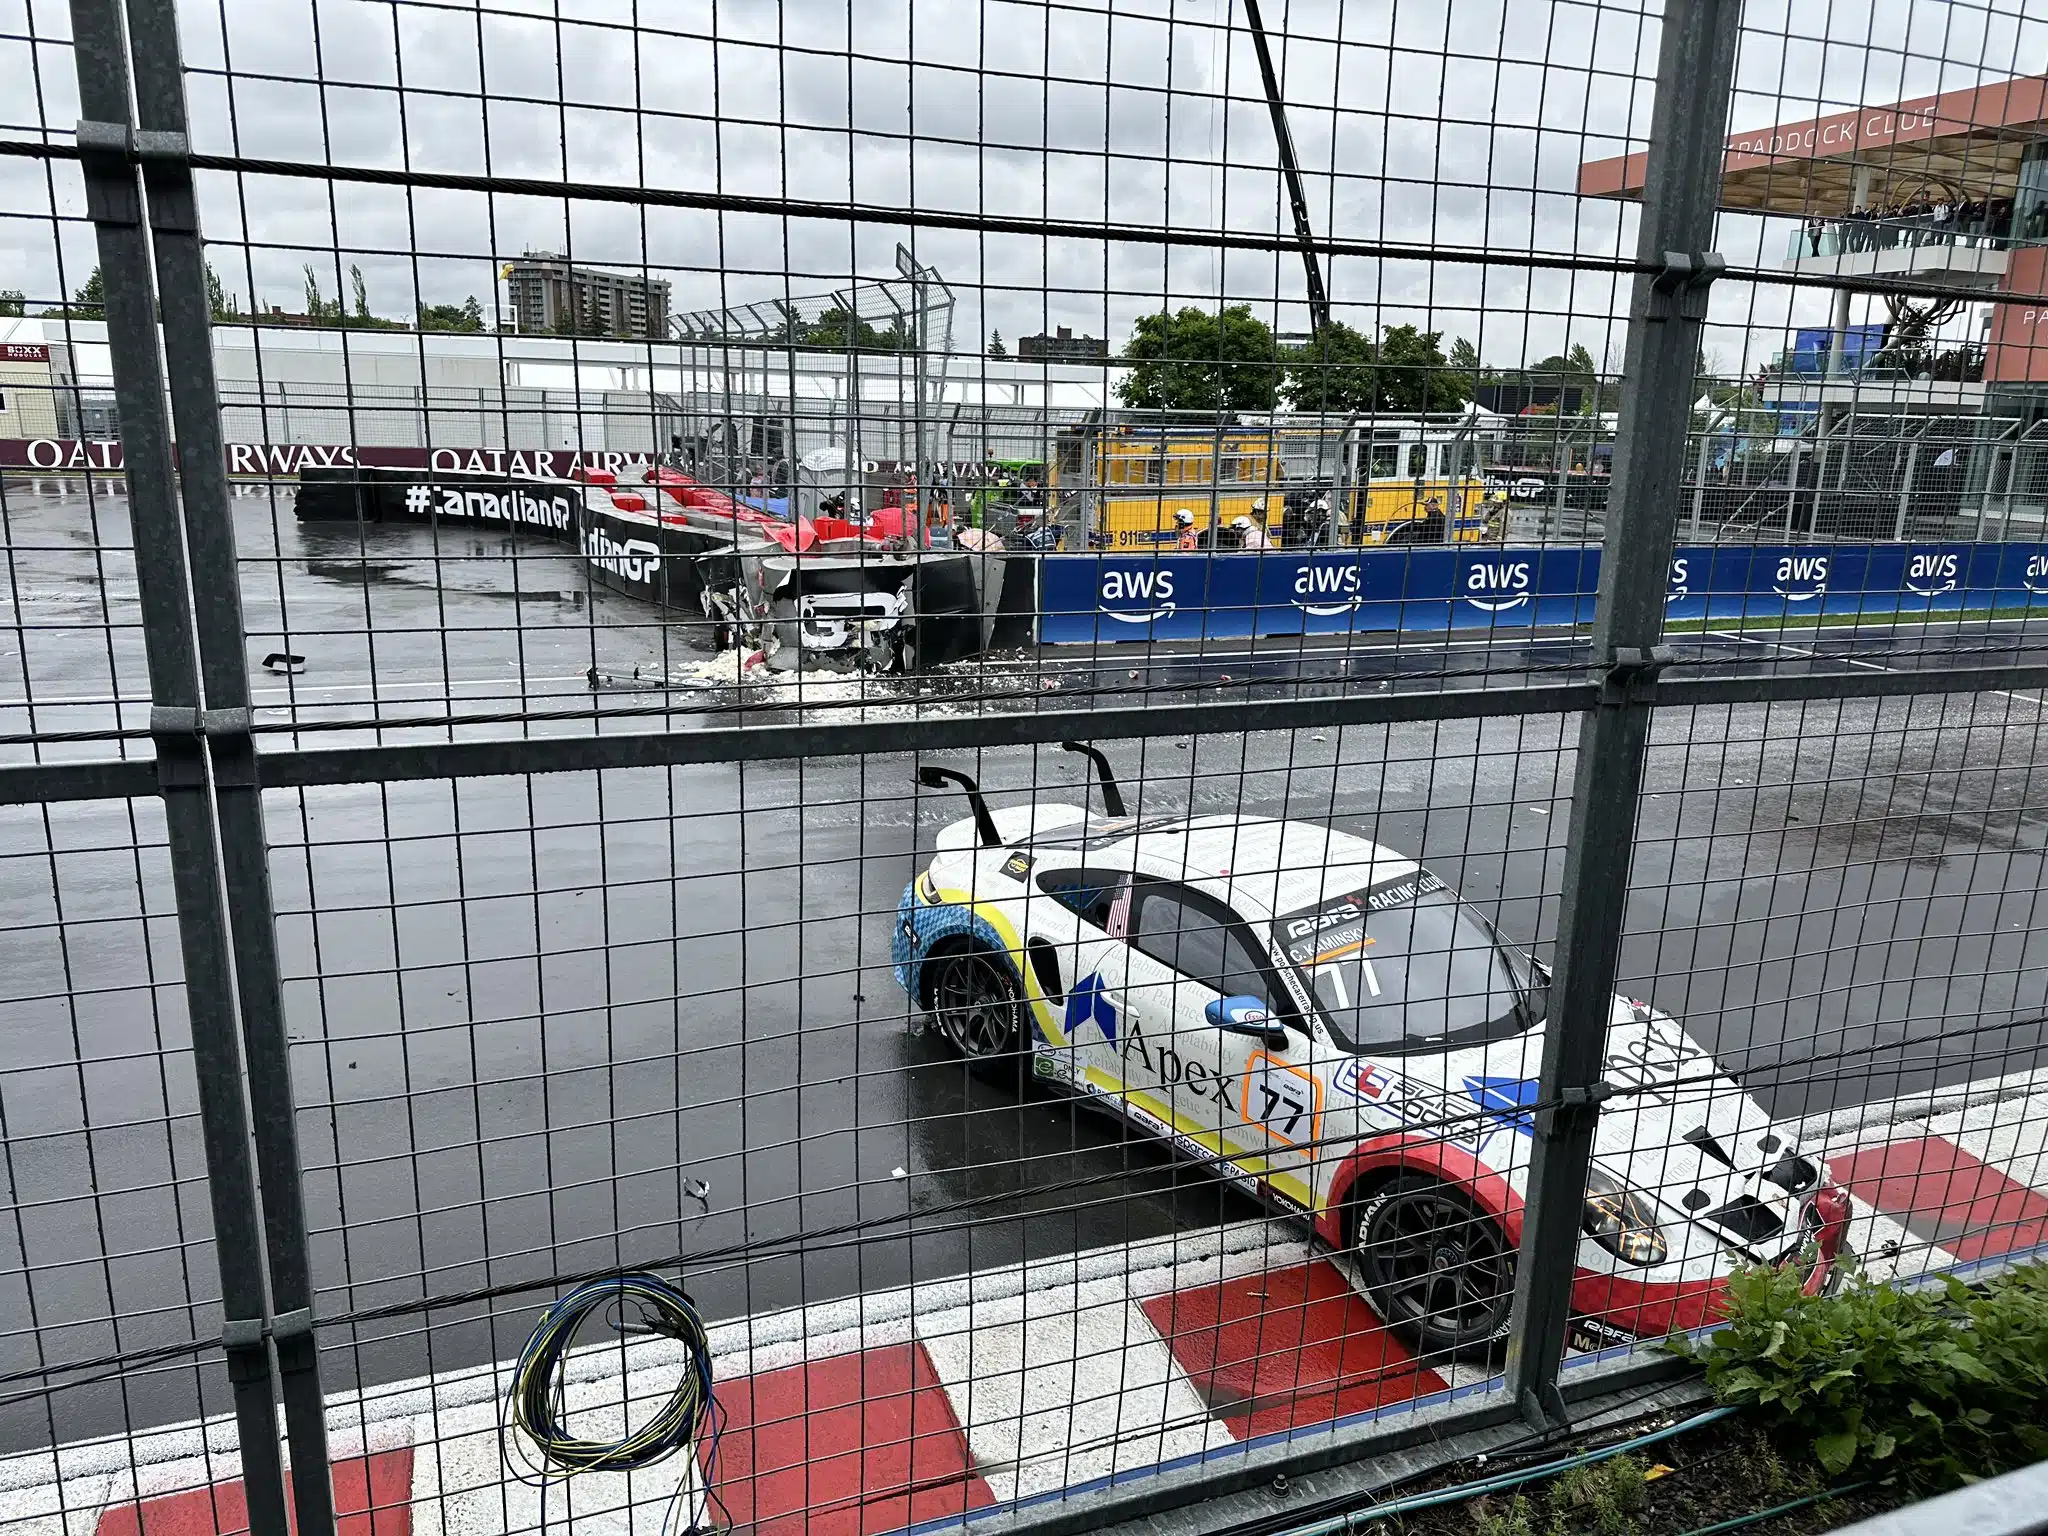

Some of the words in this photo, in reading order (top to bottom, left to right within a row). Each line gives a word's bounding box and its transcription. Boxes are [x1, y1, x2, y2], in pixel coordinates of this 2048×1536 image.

[1737, 122, 1855, 160] PADDOCK
[27, 440, 124, 468] QAT
[230, 444, 361, 474] RWAYS
[431, 449, 557, 478] QATAR
[405, 485, 570, 531] #CanadianGP
[1120, 530, 1138, 546] 911
[1294, 566, 1361, 594] aws
[1467, 563, 1530, 590] aws
[1776, 557, 1828, 581] aws
[1910, 554, 1958, 578] aws
[1102, 570, 1174, 599] aws
[1368, 882, 1418, 910] RACING
[1289, 949, 1306, 962] C.
[1303, 927, 1368, 957] KAMINSKY
[1307, 950, 1381, 1009] 77
[1152, 987, 1205, 1023] Patence
[1085, 1048, 1142, 1083] Reliablity
[1120, 1019, 1238, 1114] Apex
[1600, 1021, 1700, 1105] pex
[1259, 1083, 1305, 1136] 77
[1386, 1091, 1476, 1145] LOCKS
[1358, 1192, 1388, 1256] ADVAN
